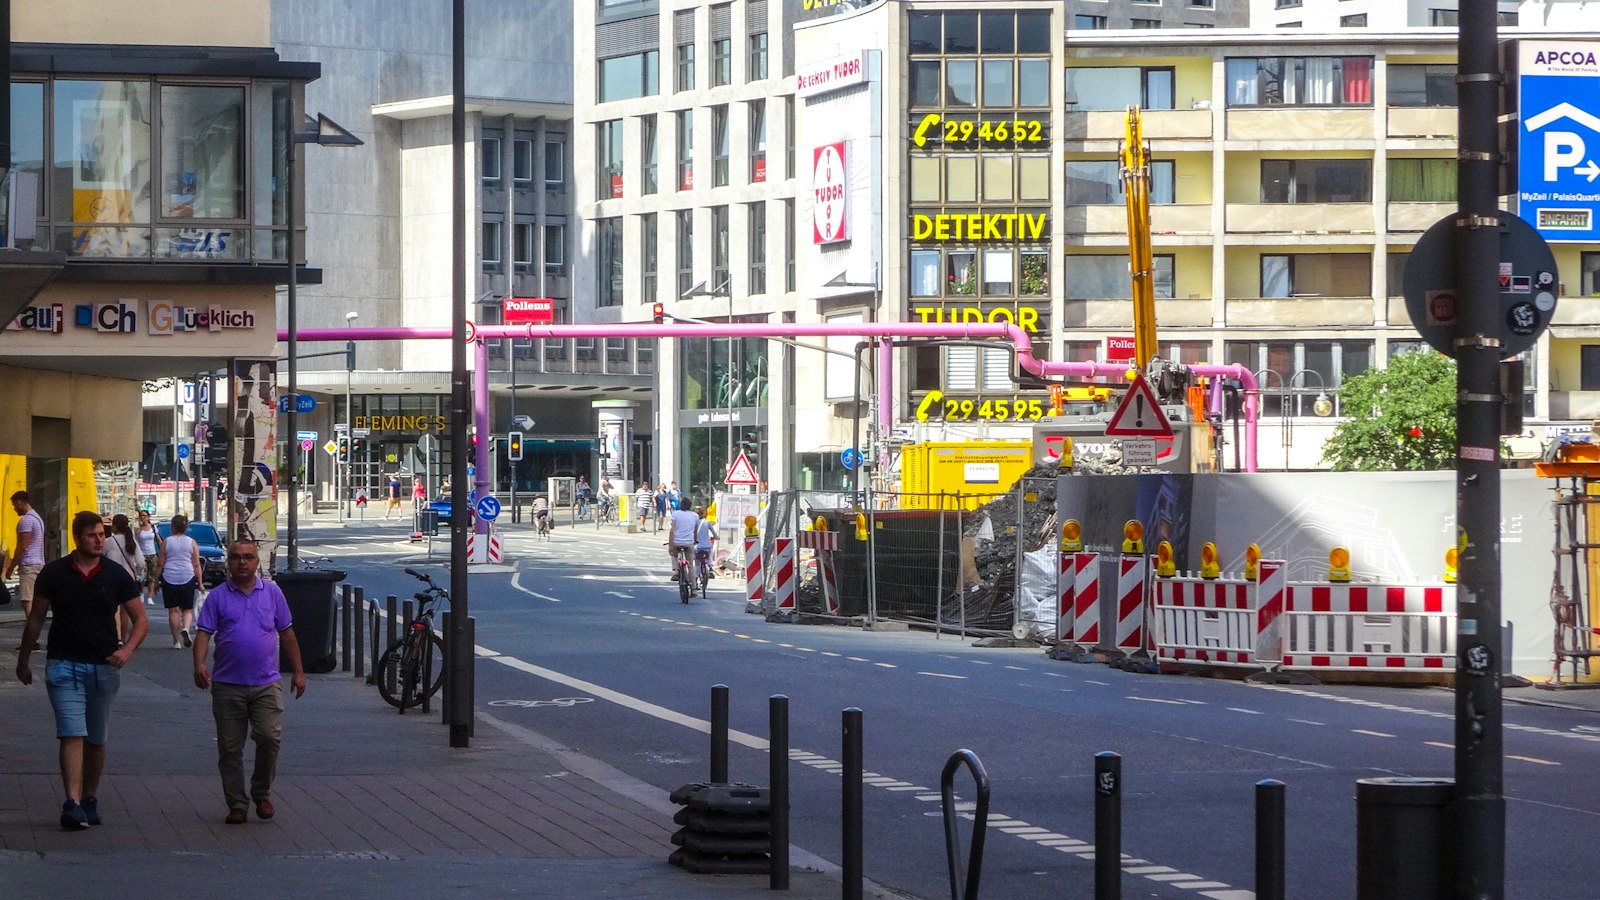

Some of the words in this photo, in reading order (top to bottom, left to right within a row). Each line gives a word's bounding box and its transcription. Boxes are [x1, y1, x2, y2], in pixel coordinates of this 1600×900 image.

[1535, 51, 1597, 65] APCOA
[833, 58, 860, 80] TUDOR
[944, 120, 974, 141] 29
[978, 120, 1008, 141] 46
[1013, 120, 1042, 141] 52
[815, 184, 844, 204] TUDOR
[1522, 192, 1547, 203] MyZeil
[913, 213, 1046, 240] DETEKTIV
[1539, 213, 1587, 227] EINFAHRT
[505, 301, 550, 311] Pollems
[915, 307, 1039, 333] TUDOR
[945, 399, 974, 420] 29
[978, 399, 1009, 420] 45
[1013, 399, 1042, 420] 95
[355, 415, 446, 431] FLEMING'S
[1128, 450, 1151, 458] führung
